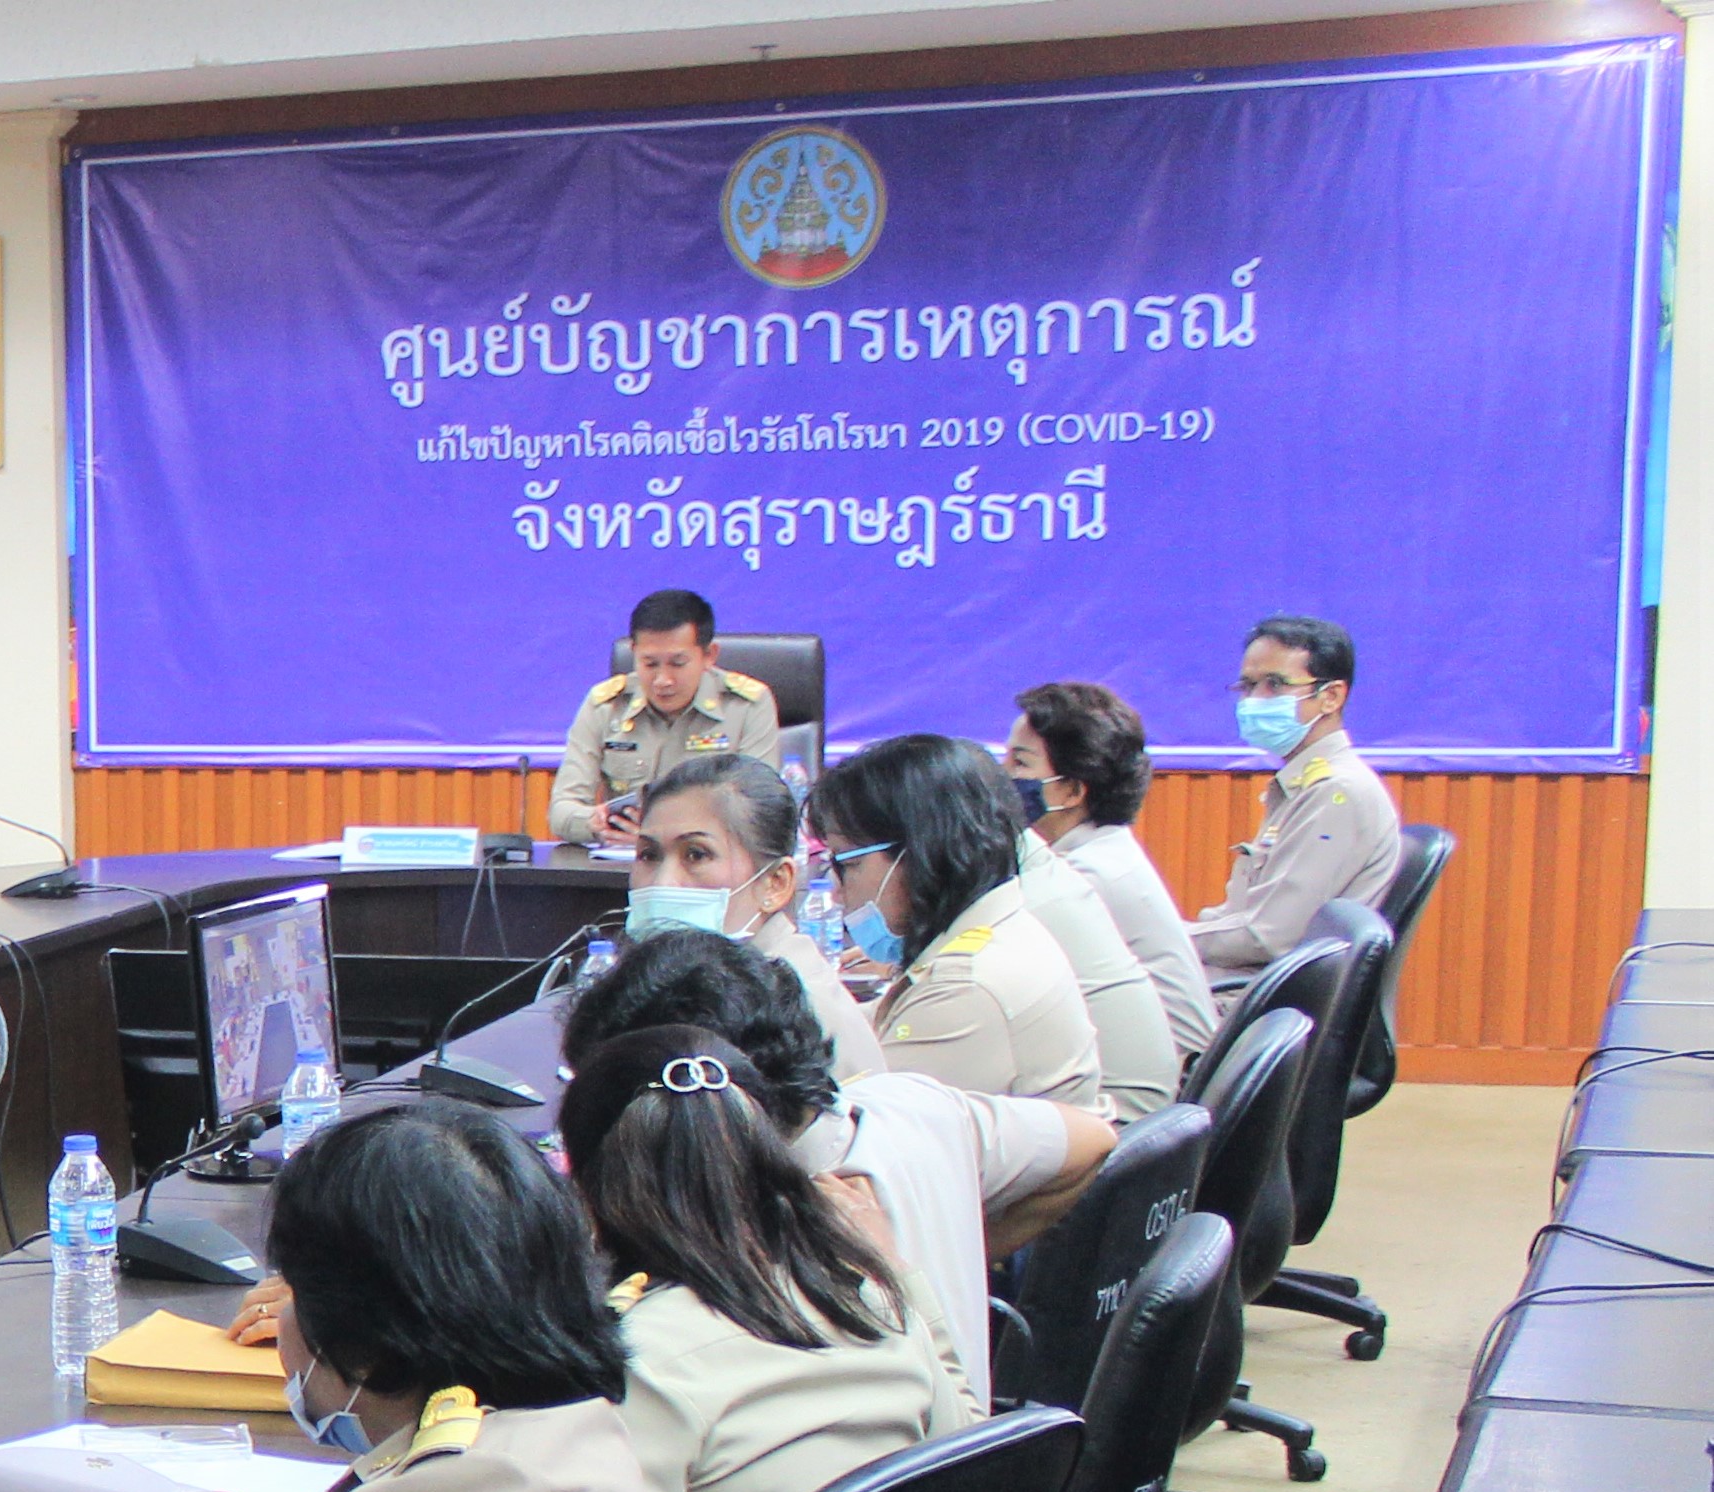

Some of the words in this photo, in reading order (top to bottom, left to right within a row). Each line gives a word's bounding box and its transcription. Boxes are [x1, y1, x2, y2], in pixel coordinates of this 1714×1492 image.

[380, 257, 1264, 407] ศูนย์บัญชาการเหตุการณ์
[416, 406, 907, 469] แก้ไขปัญหาโรคติดเชื้อไวรัสโคโรนา
[921, 419, 1005, 450] 2019
[1018, 406, 1216, 450] (COVID-19)
[511, 462, 1108, 568] จังหวัดสุราษฎร์ธานี
